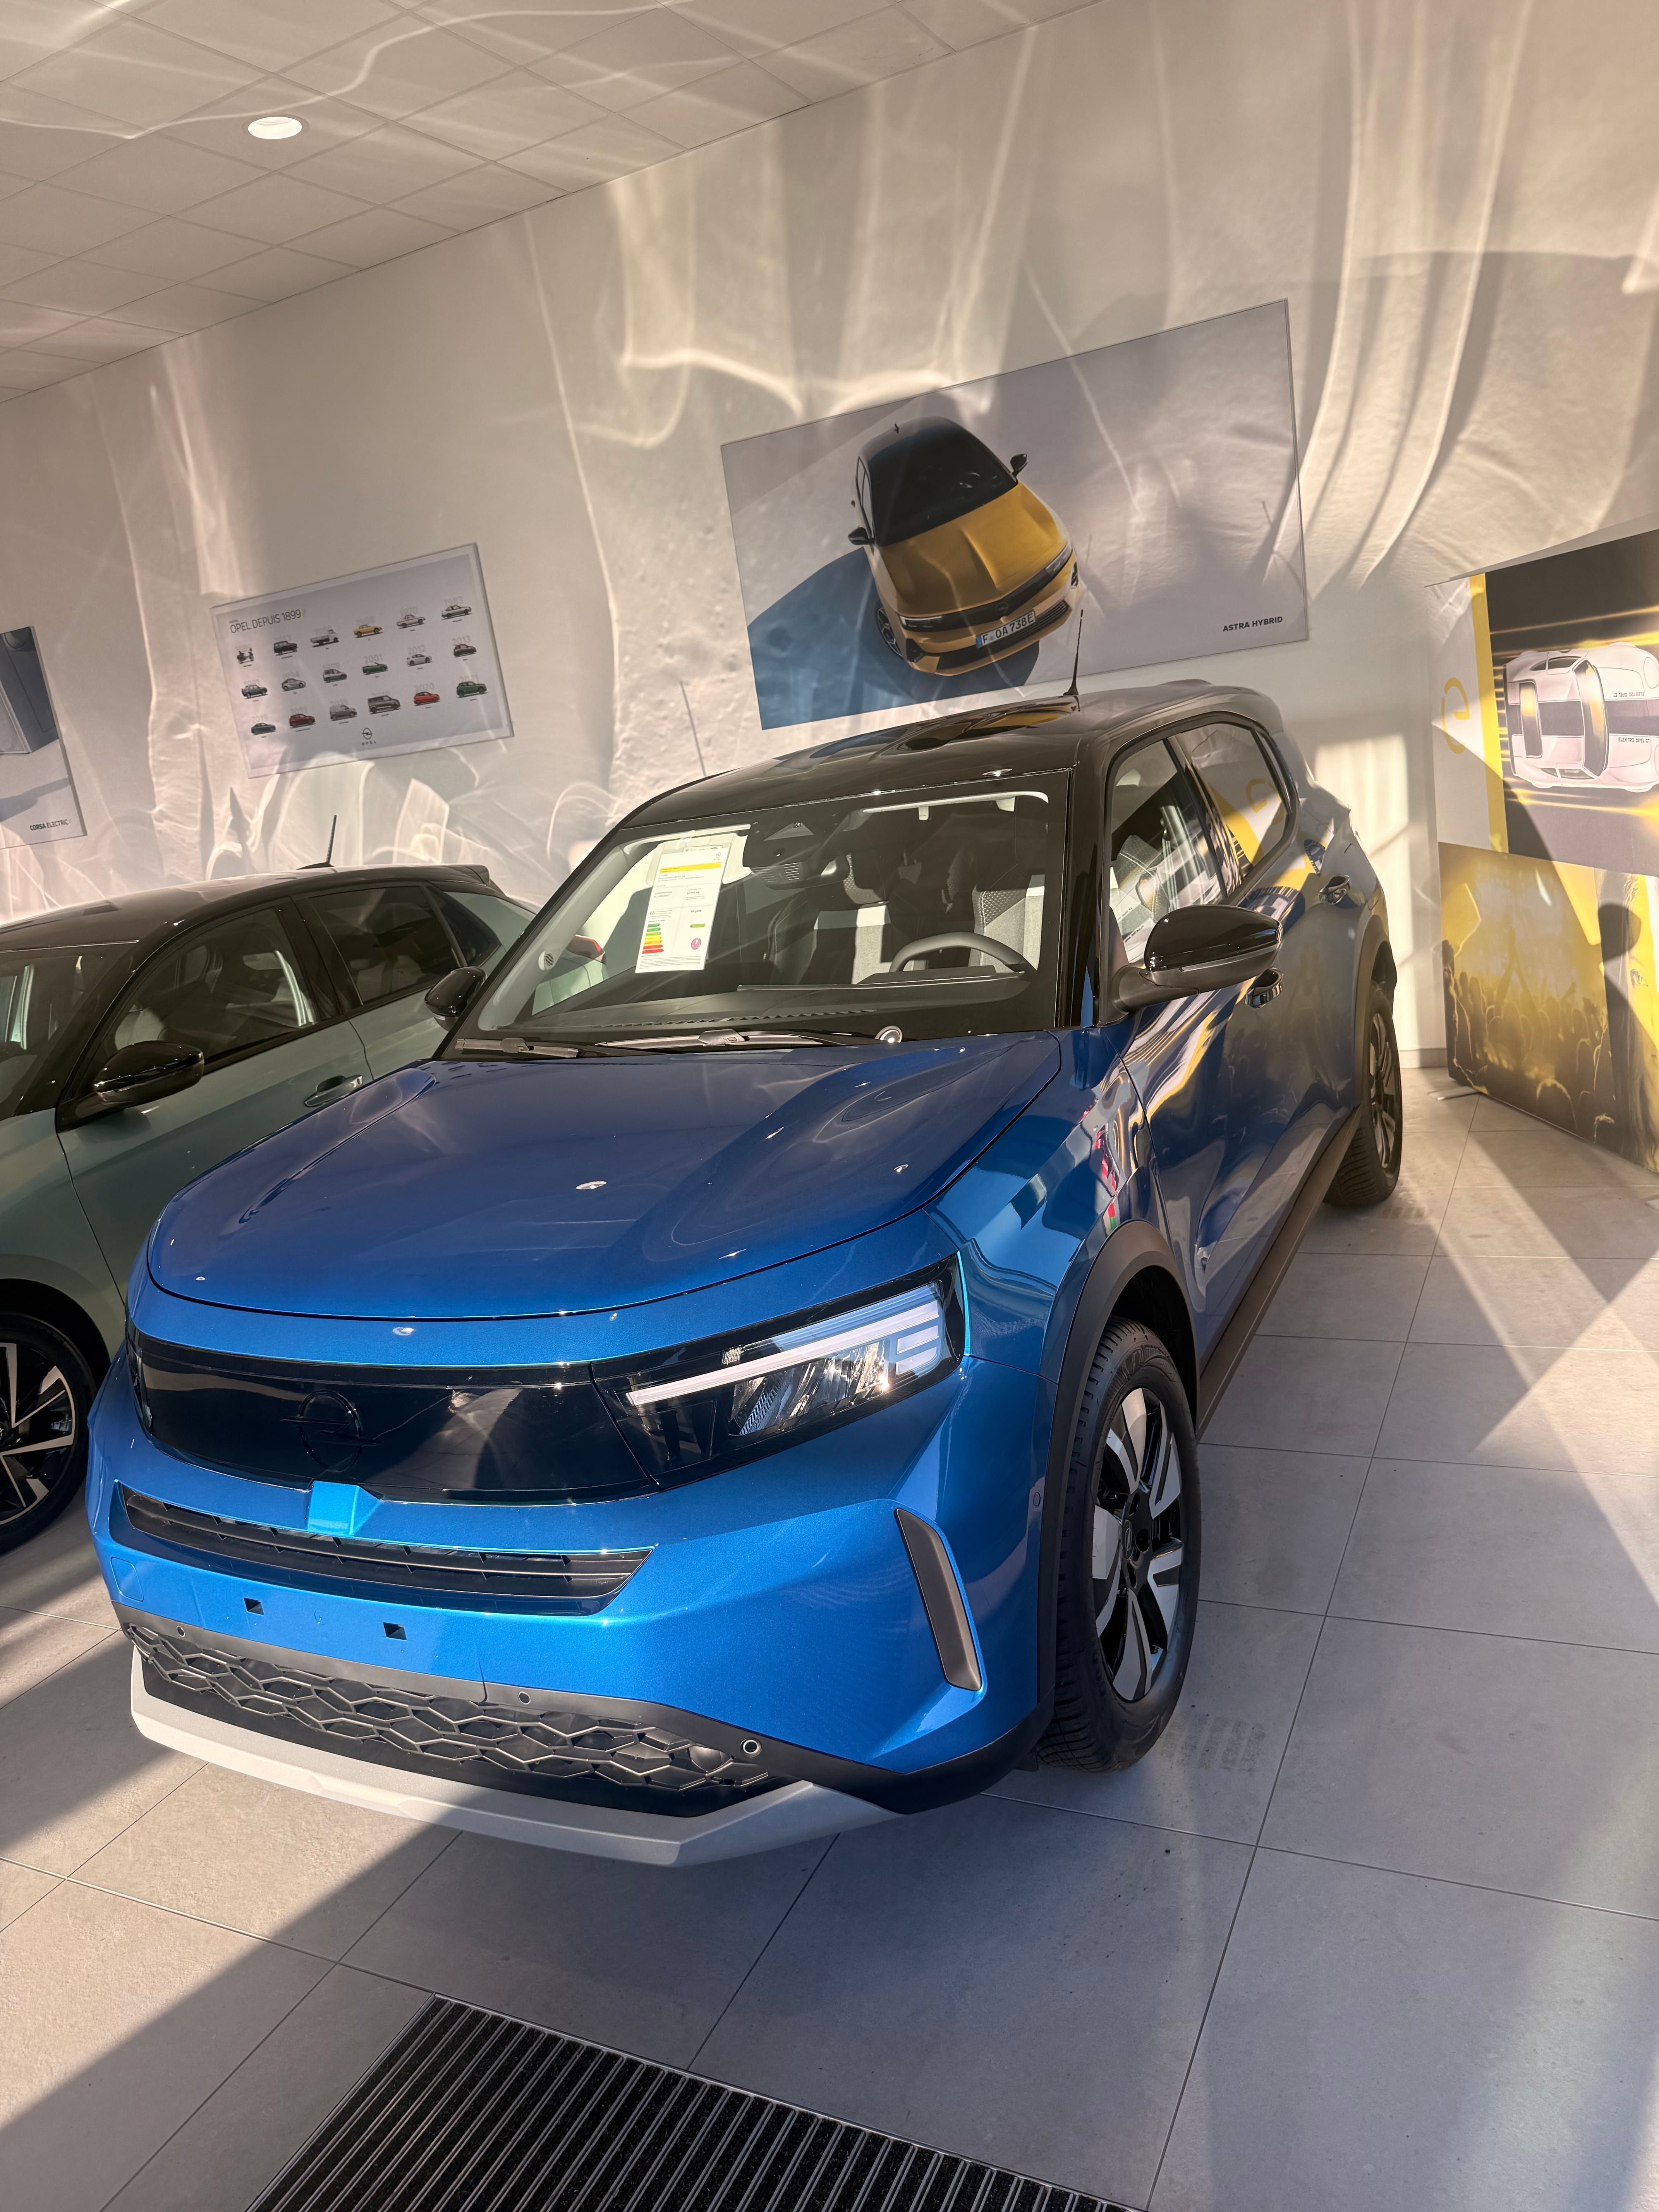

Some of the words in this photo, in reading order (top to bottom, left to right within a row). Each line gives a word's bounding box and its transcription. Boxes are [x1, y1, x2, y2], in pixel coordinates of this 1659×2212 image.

[230, 622, 251, 633] OPEL
[252, 614, 281, 629] DEPUIS
[281, 609, 301, 622] 1899
[1223, 622, 1250, 632] ASTRA
[1252, 616, 1283, 627] HYBRID
[982, 634, 989, 644] F
[996, 627, 1008, 638] OA
[1009, 613, 1034, 632] 738E
[408, 644, 426, 654] 2012
[364, 654, 383, 663] 2001
[46, 819, 69, 828] ELECTRIC
